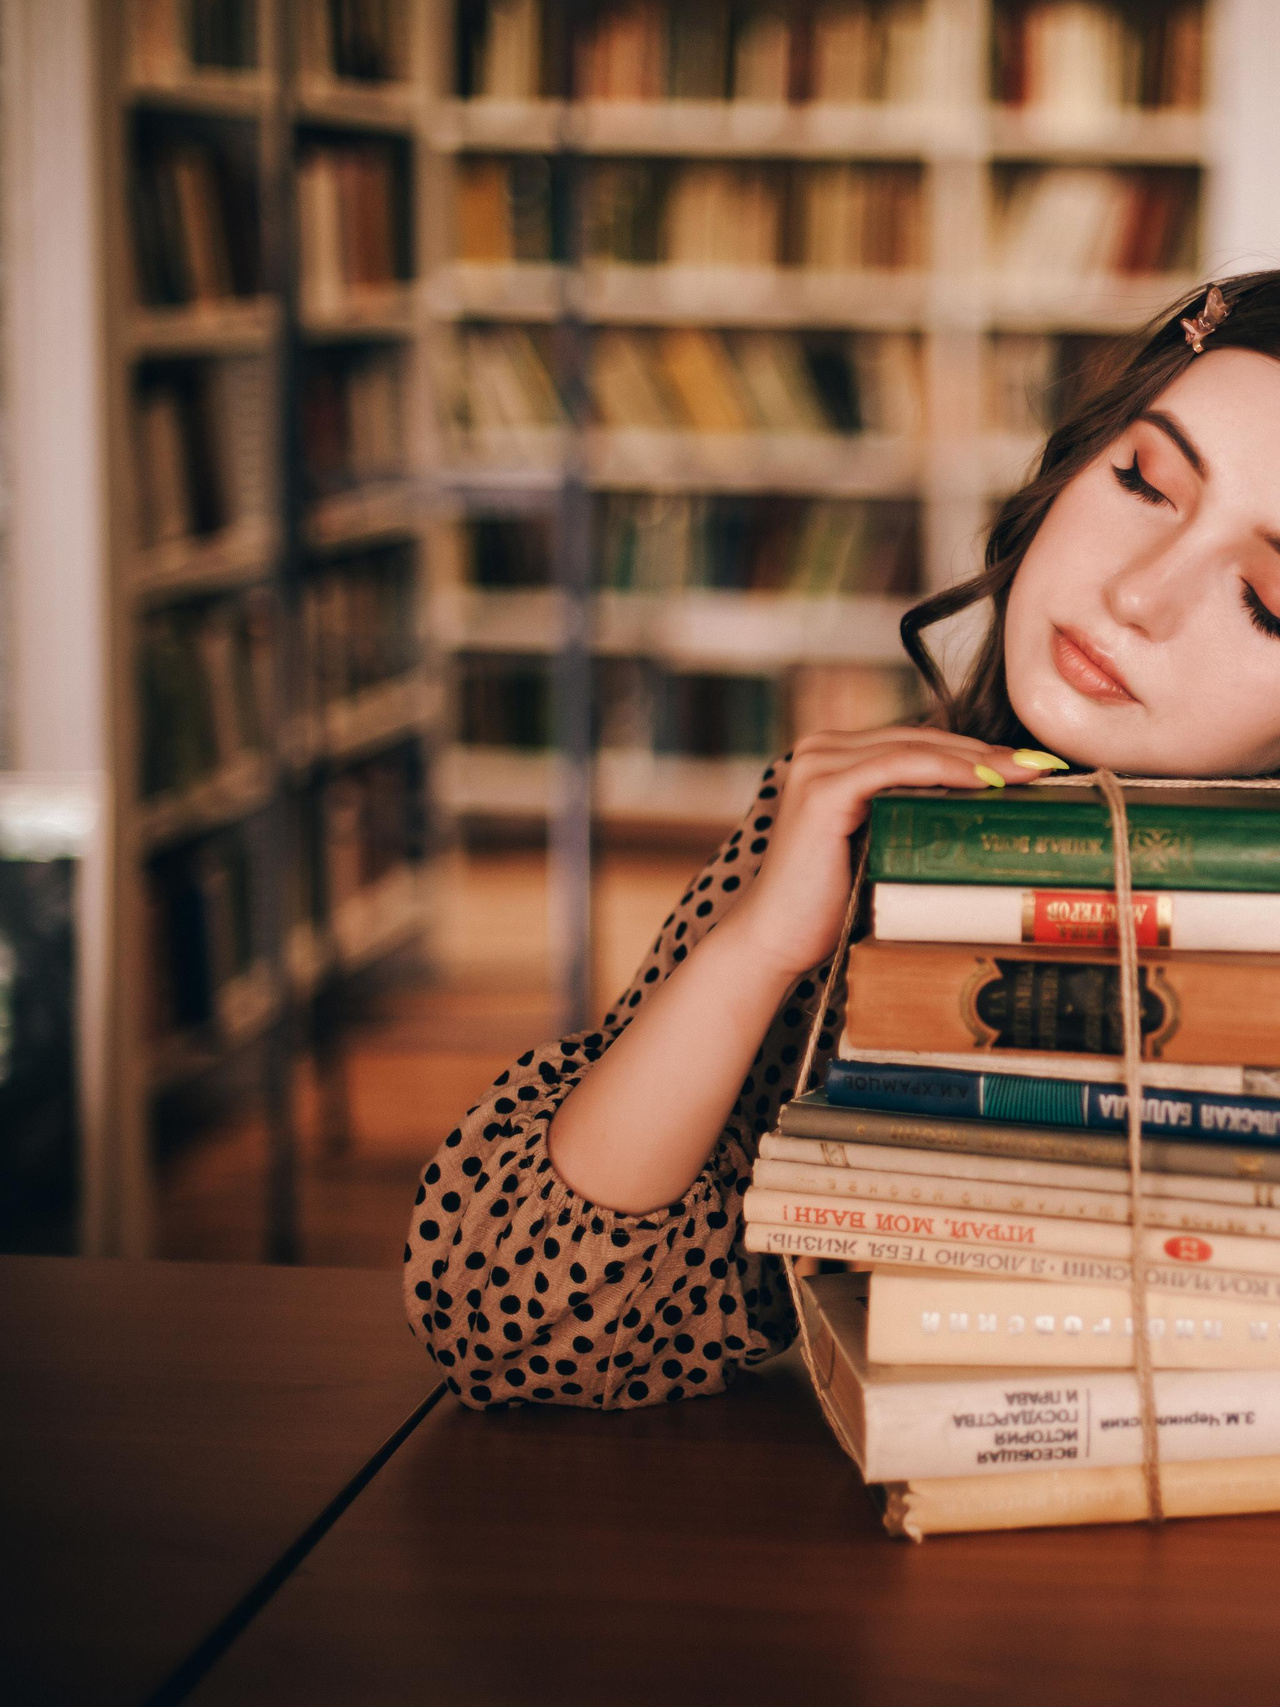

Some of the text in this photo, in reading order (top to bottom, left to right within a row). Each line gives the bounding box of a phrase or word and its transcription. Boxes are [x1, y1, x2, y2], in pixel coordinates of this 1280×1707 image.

[1046, 901, 1148, 924] МСТЕРОВ
[1099, 1093, 1193, 1127] БАЛЛДА
[876, 1212, 934, 1235] МОЙ
[944, 1218, 1036, 1244] ИГРАЙ,
[766, 1231, 858, 1252] ЖИЗНЬ!
[935, 1252, 1025, 1272] ЛЮБЛЮ
[1031, 1257, 1046, 1275] Я
[1063, 1261, 1270, 1297] КОЛМАНОСКИЙ
[1005, 1390, 1078, 1406] И ПРАВА
[953, 1409, 1078, 1429] ГОСУДАРСТВА
[994, 1430, 1078, 1446] ИСТОРИЯ
[977, 1447, 1078, 1465] ВСЕОБЩАЯ
